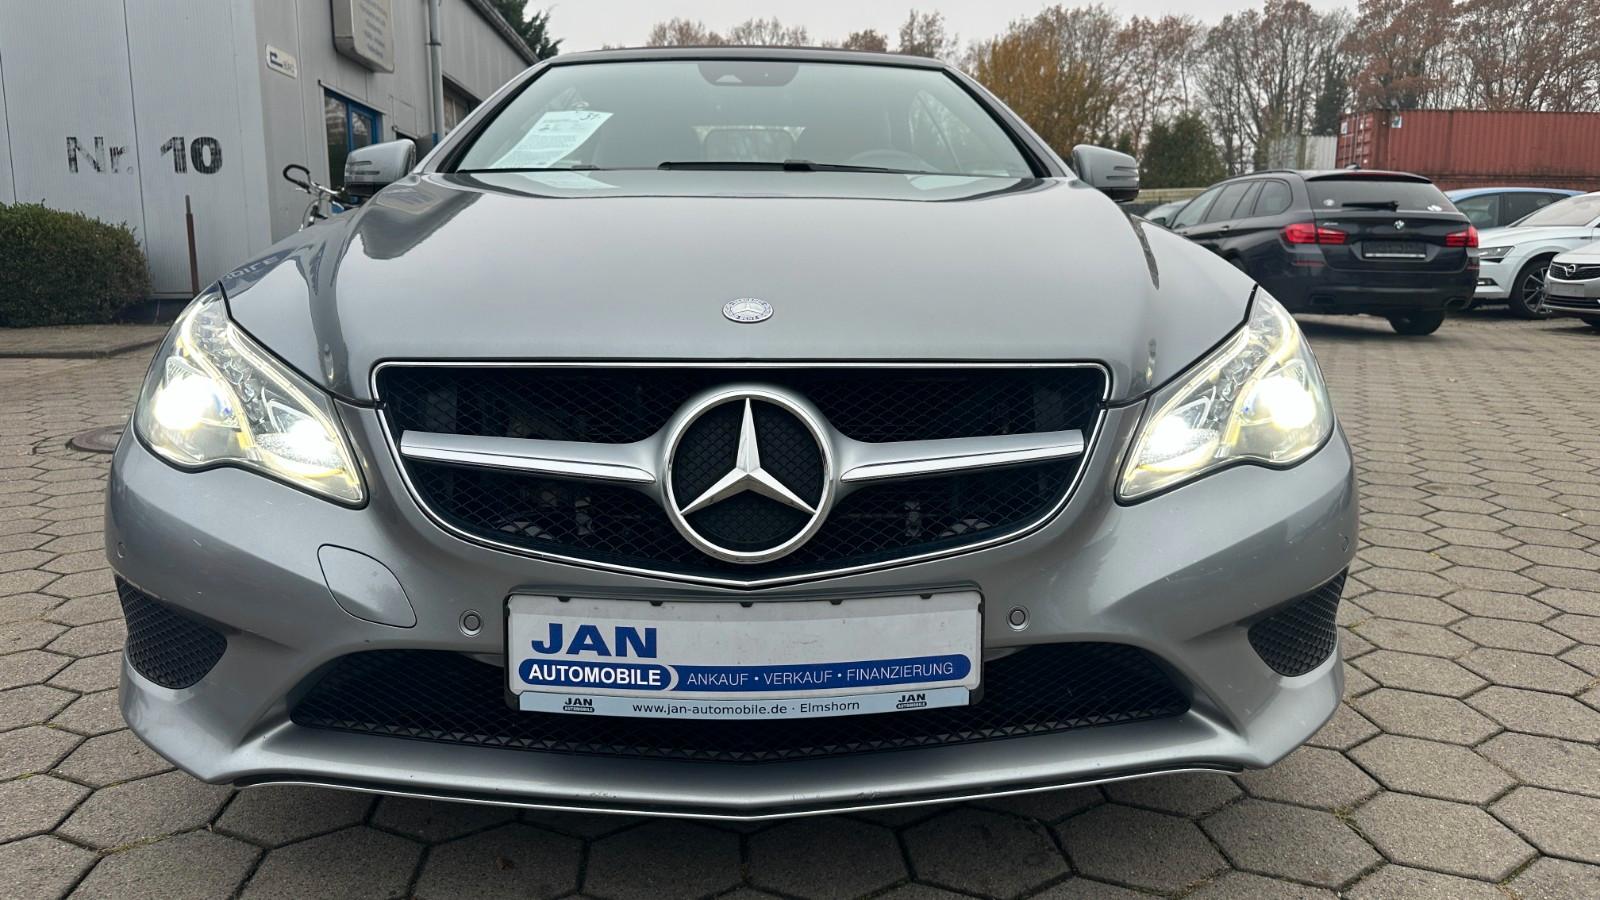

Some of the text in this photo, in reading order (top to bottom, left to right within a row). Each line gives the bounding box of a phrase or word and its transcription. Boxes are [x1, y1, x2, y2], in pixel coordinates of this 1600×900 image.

[66, 136, 223, 175] Nr. 10
[531, 622, 657, 659] JAN
[528, 663, 662, 686] AUTOMOBILE
[686, 661, 953, 686] ANKAUF VERKAUF FINANZIERUNG
[564, 697, 593, 706] JAN
[632, 701, 860, 715] www.jan-automobile.de Elmshorn
[898, 693, 926, 702] JAN
